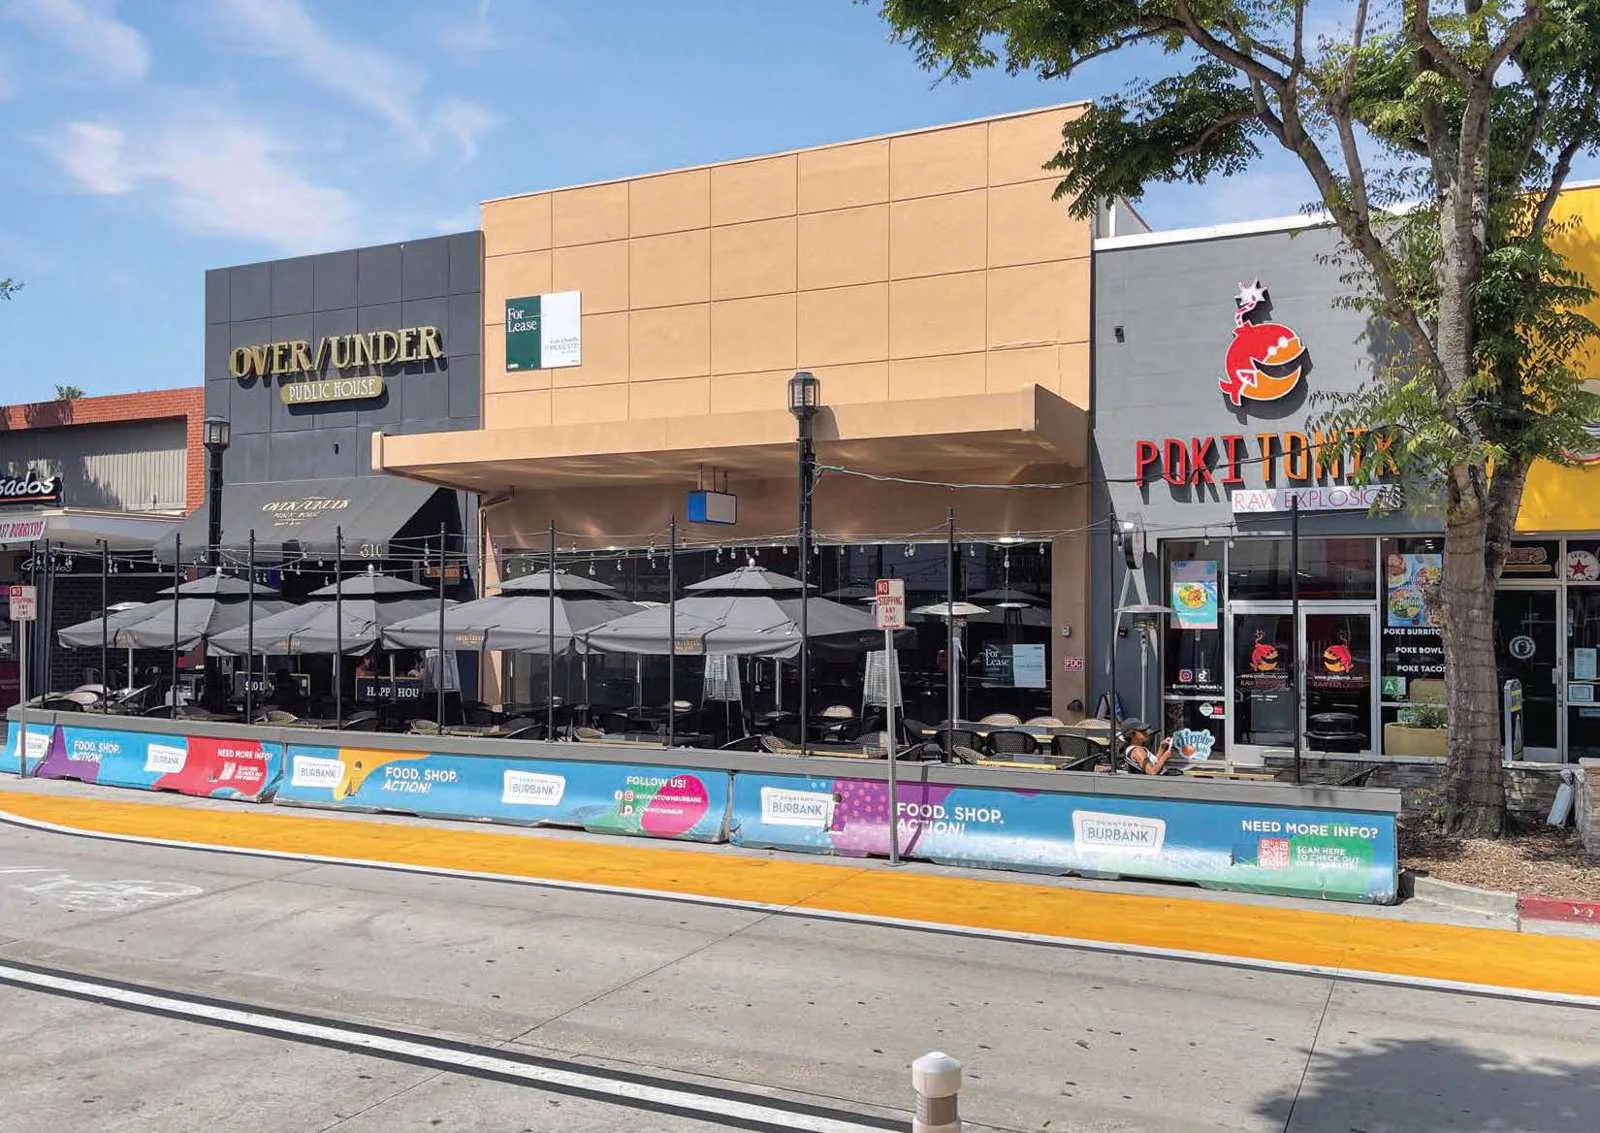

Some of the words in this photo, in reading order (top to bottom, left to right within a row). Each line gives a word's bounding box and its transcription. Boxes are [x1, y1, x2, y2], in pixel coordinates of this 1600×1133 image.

[507, 308, 525, 321] For
[507, 320, 537, 333] Lease
[229, 326, 445, 377] OVER/UNDER
[288, 383, 330, 401] PUBLIC
[334, 378, 376, 398] HOUSE
[1136, 434, 1244, 487] POKI
[1234, 492, 1278, 510] RAW
[361, 544, 382, 558] 310
[879, 582, 888, 593] NO
[879, 596, 903, 606] STOPPING
[1384, 628, 1405, 636] POKE
[985, 648, 999, 658] For
[985, 658, 1009, 667] Lease
[1396, 665, 1419, 673] POKE
[1384, 680, 1394, 690] A
[74, 741, 97, 751] FOOD.
[99, 743, 121, 754] SHOP.
[217, 748, 235, 758] NEED
[301, 767, 336, 778] BURBANK
[385, 766, 420, 780] FOOD.
[424, 769, 458, 783] SHOP.
[382, 780, 431, 793] ACTION!
[626, 776, 668, 787] FOLLOW
[670, 779, 687, 788] US!
[512, 783, 553, 795] BURBANK
[772, 802, 822, 815] BURBANK
[897, 802, 949, 819] FOOD.
[955, 807, 1004, 824] SHOP.
[897, 818, 966, 836] ACTION!
[1242, 820, 1281, 832] NEED
[1285, 823, 1328, 836] MORE
[1333, 826, 1378, 838] INFO?
[1087, 827, 1149, 842] BURBANK
[1296, 846, 1320, 854] SCAN
